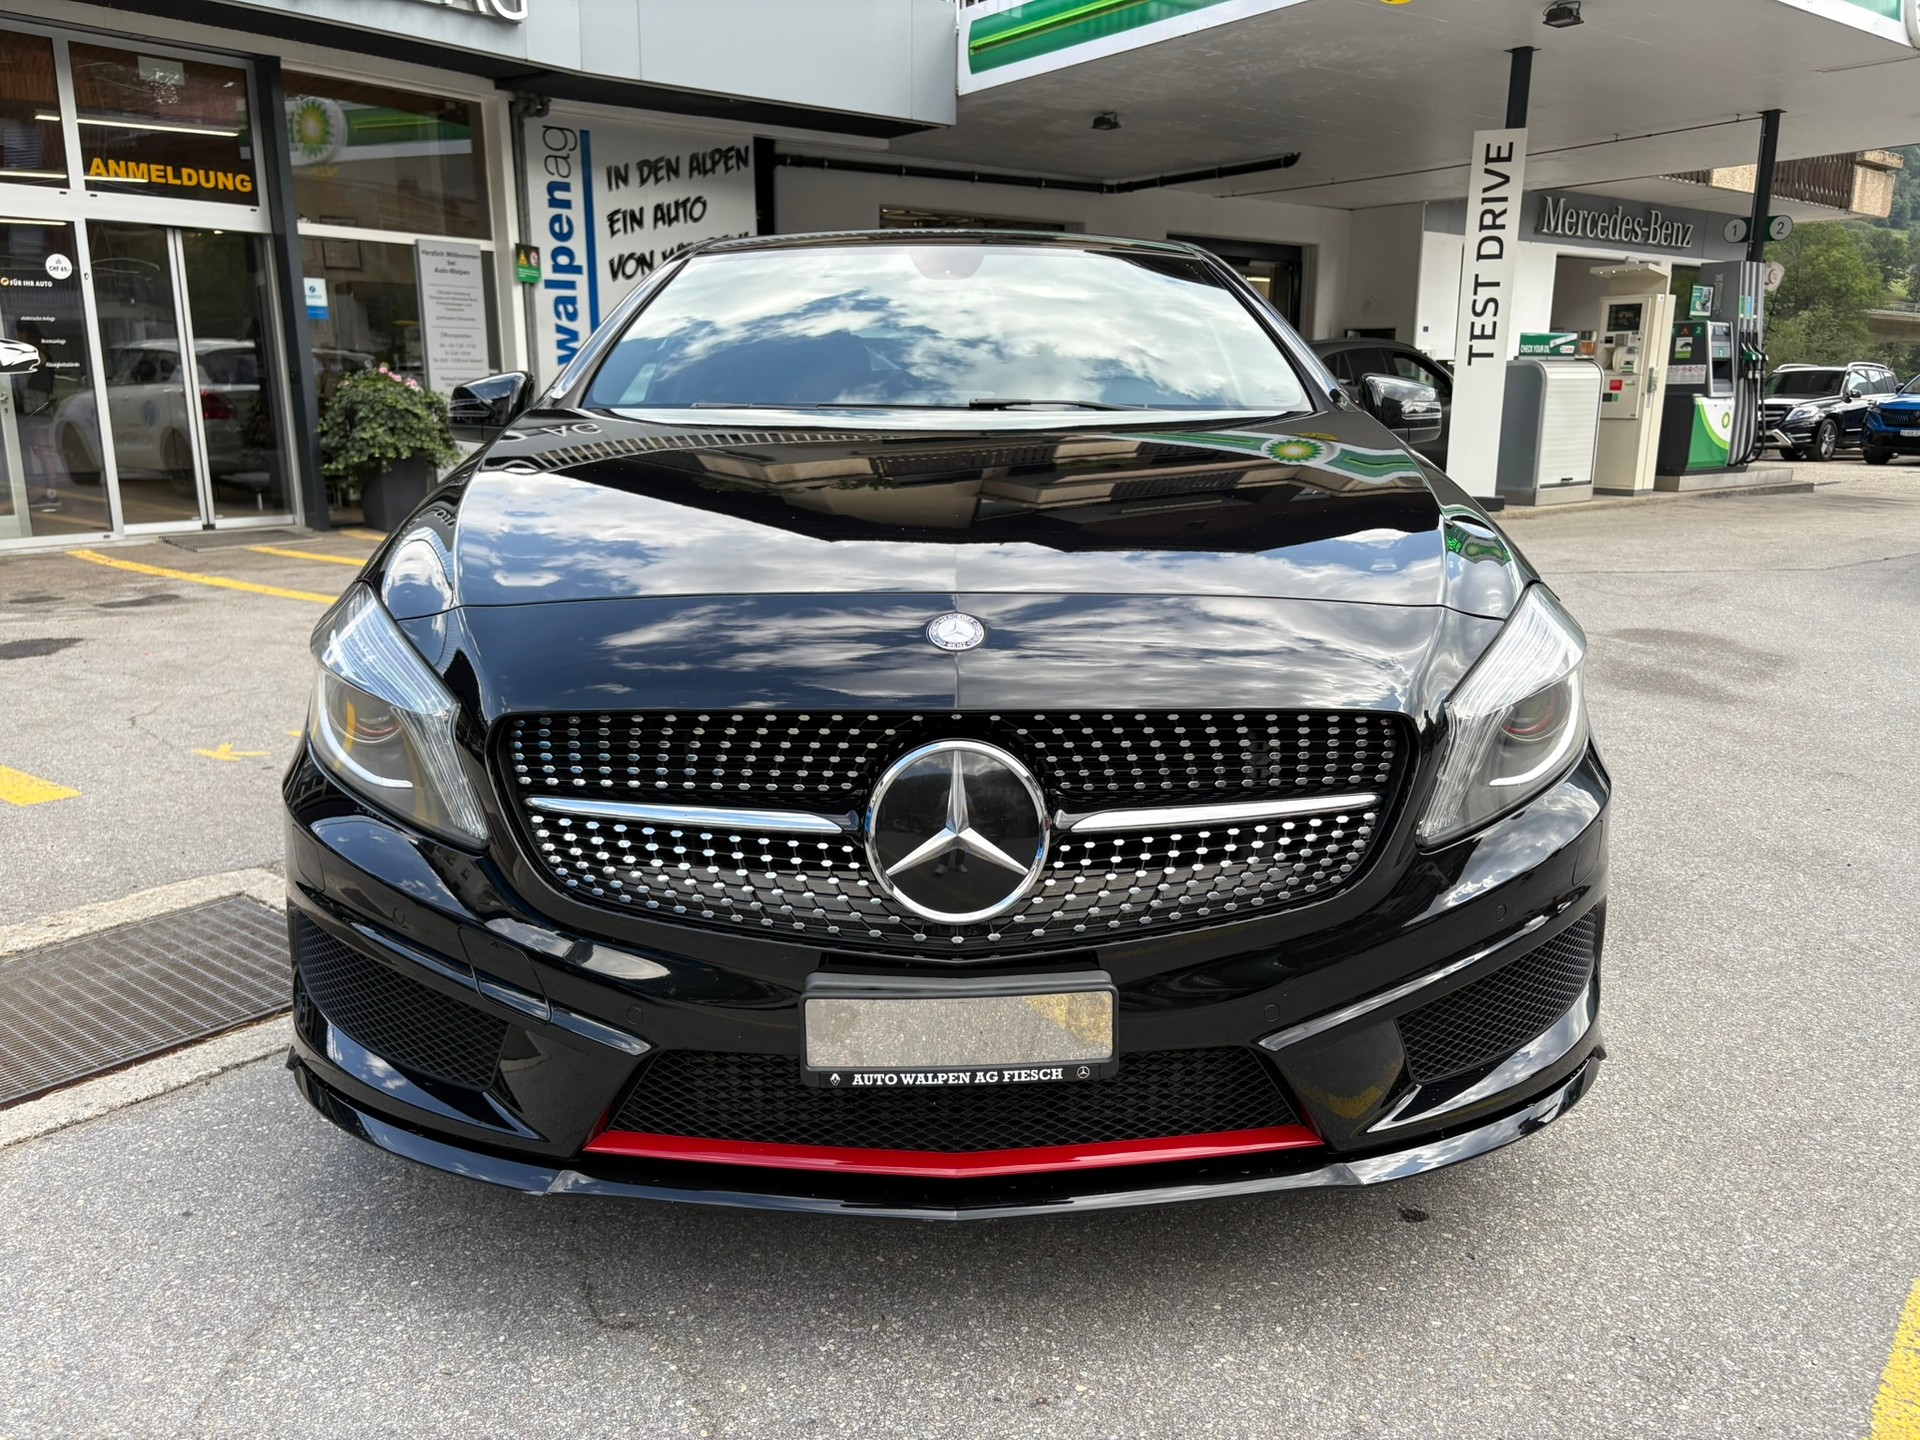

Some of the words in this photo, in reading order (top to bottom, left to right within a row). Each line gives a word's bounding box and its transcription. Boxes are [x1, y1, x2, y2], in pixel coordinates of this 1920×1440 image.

[89, 157, 253, 193] ANMELDUNG
[605, 162, 630, 192] IN
[635, 155, 681, 188] DEN
[688, 145, 750, 179] ALPEN
[606, 206, 644, 239] EIN
[652, 195, 708, 230] AUTO
[1476, 141, 1514, 262] DRIVE
[1541, 196, 1694, 248] Mercedes-Benz
[1731, 224, 1737, 237] 1
[1776, 221, 1785, 235] 2
[608, 249, 655, 282] VON
[36, 280, 53, 288] AUTO
[1467, 273, 1501, 366] TEST
[852, 1073, 898, 1086] AUTO
[900, 1071, 971, 1086] WALPEN
[974, 1069, 999, 1083] AG
[1002, 1067, 1063, 1083] FIESCH
